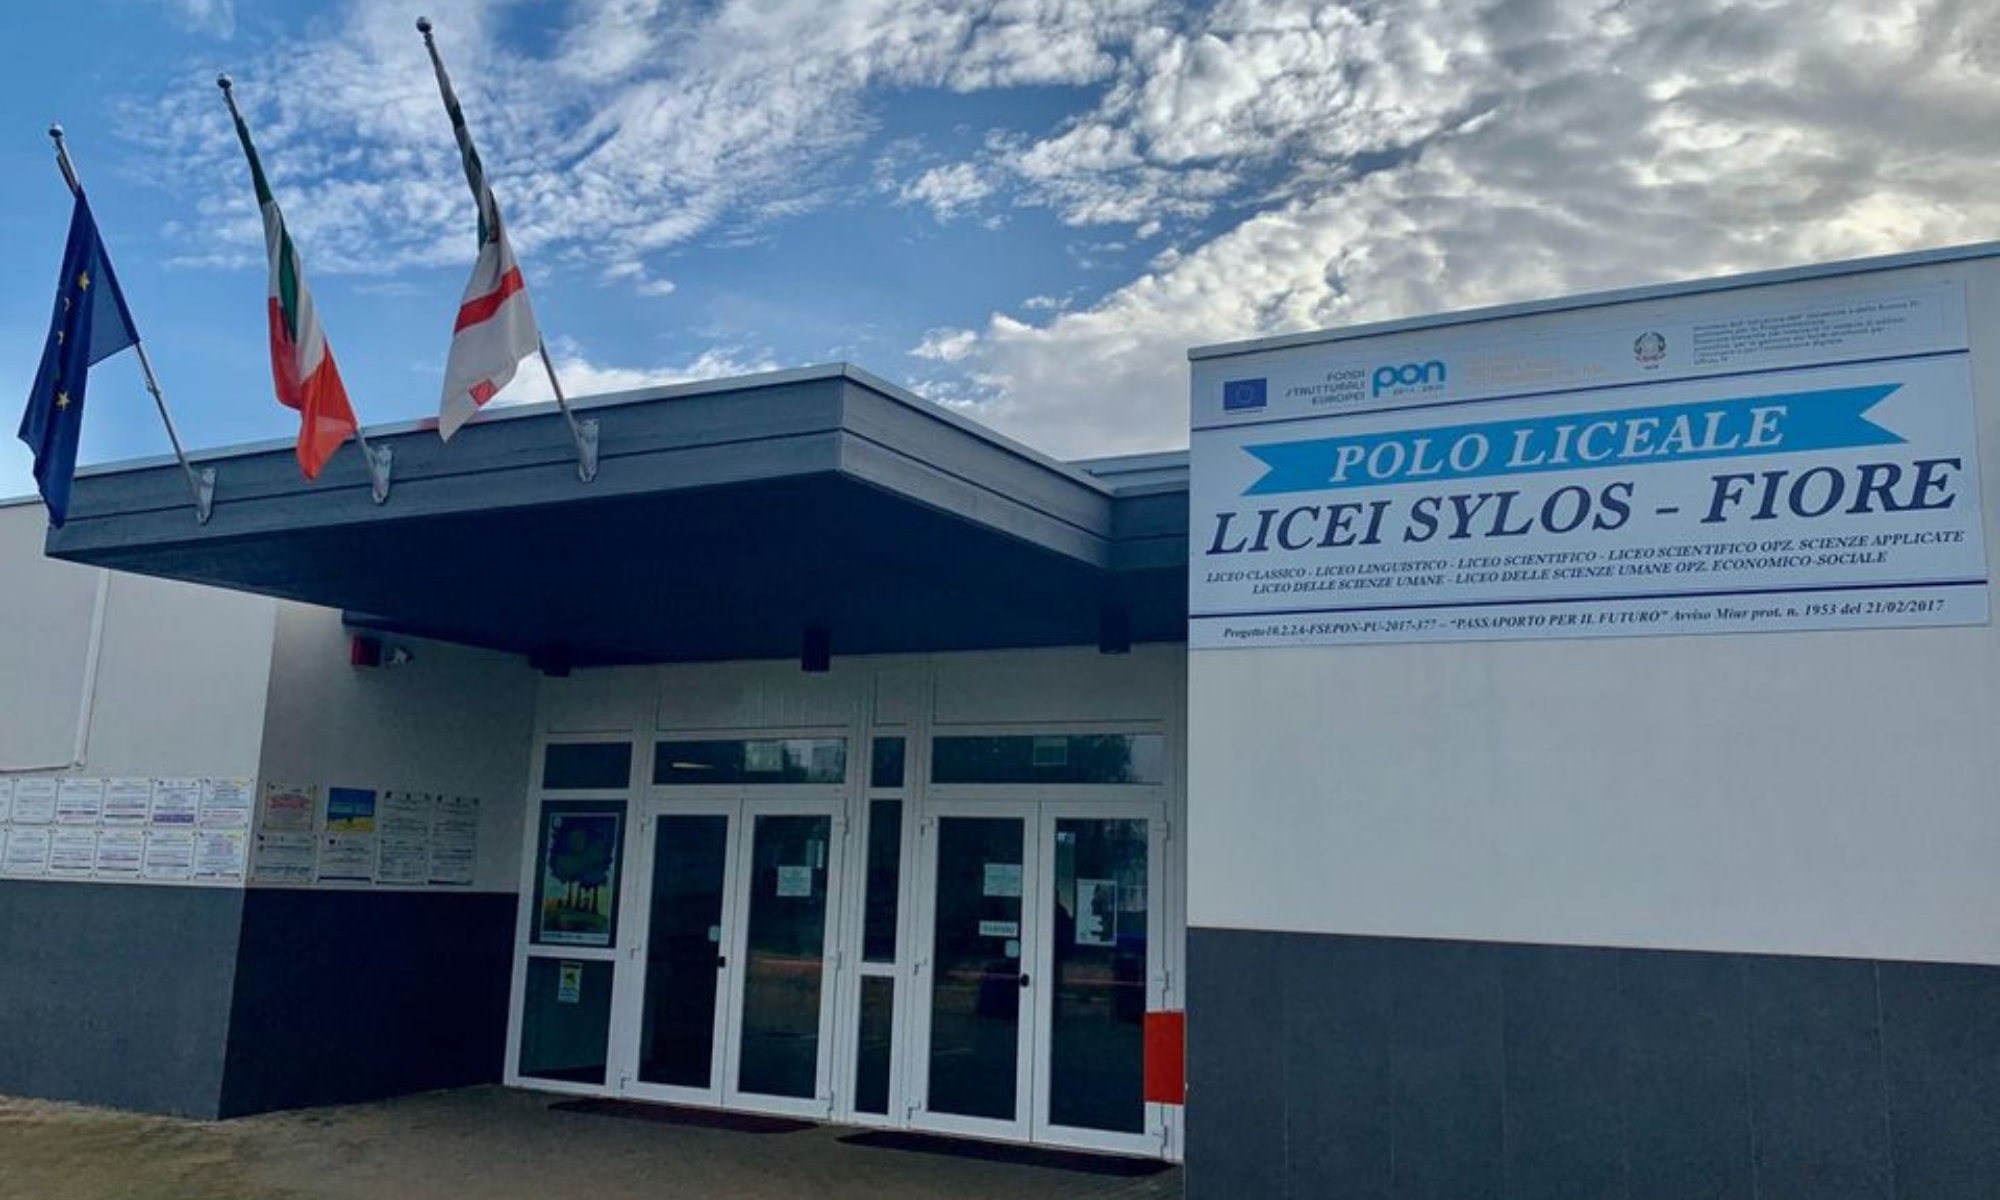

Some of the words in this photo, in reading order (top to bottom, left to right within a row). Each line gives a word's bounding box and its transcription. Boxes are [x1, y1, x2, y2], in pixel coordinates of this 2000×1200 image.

[1372, 360, 1446, 398] pon
[1328, 433, 1489, 482] POLO
[1505, 405, 1788, 468] LICEALE
[1206, 500, 1391, 555] LICEI
[1403, 481, 1634, 542] SYLOS
[1701, 458, 1962, 524] FIORE
[1206, 571, 1245, 583] LICEO
[1246, 567, 1306, 581] CLASSICO
[1315, 564, 1356, 577] LICEO
[1358, 560, 1448, 575] LINGUISTICO
[1458, 556, 1501, 569] LICEO
[1503, 551, 1597, 567] SCIENTIFICO
[1608, 547, 1655, 560] LICEO
[1656, 541, 1757, 558] SCIENTIFICO
[1760, 539, 1794, 552] OPZ.
[1799, 535, 1869, 551] SCIENZE
[1871, 530, 1966, 547] APPLICATE
[1252, 582, 1291, 594] LICEO
[1292, 579, 1337, 592] DELLE
[1337, 576, 1393, 590] SCIENZE
[1396, 574, 1446, 587] UMANE
[1456, 571, 1499, 584] LICEO
[1501, 568, 1550, 582] DELLE
[1551, 565, 1614, 580] SCIENZE
[1618, 562, 1675, 576] UMANE
[1675, 559, 1708, 573] OPZ.
[1549, 613, 1577, 626] PER
[1579, 612, 1596, 625] IL
[1670, 609, 1711, 621] Avviso
[1714, 607, 1748, 620] Miur
[1751, 606, 1783, 621] prot.
[1786, 607, 1799, 618] n.
[1805, 603, 1838, 616] 1953
[1840, 602, 1863, 615] del
[1866, 599, 1945, 614] 21/02/2017
